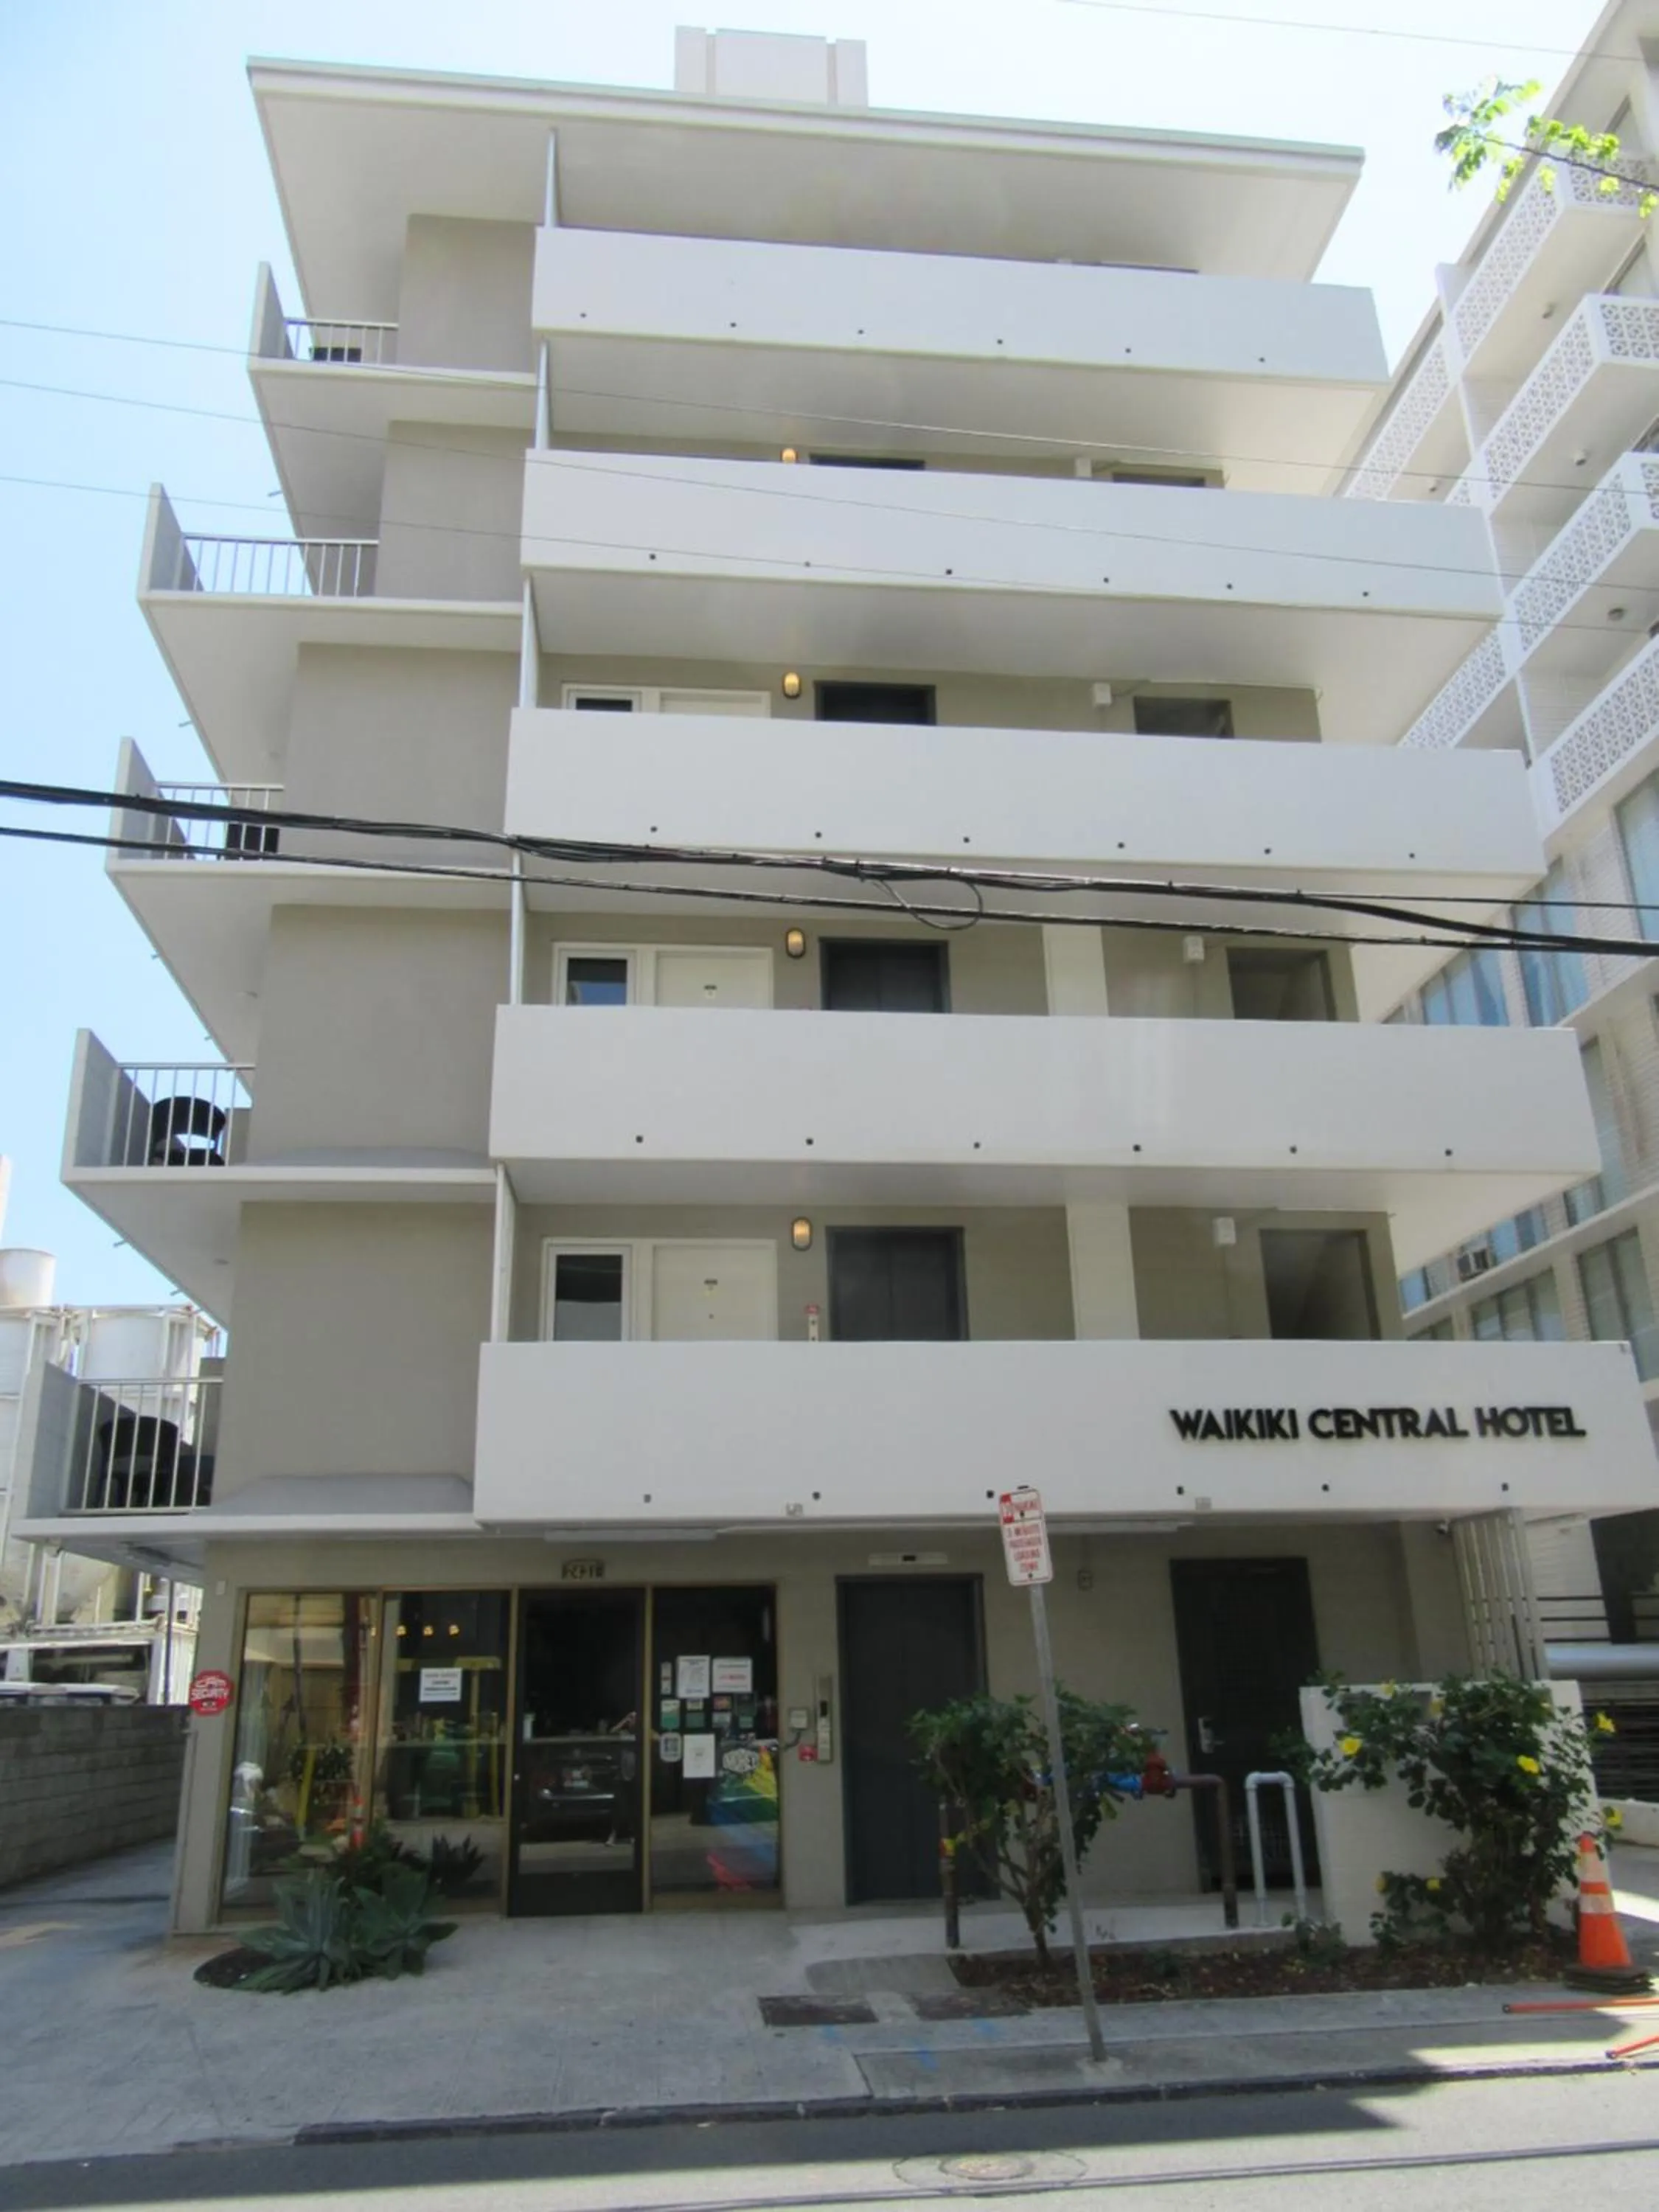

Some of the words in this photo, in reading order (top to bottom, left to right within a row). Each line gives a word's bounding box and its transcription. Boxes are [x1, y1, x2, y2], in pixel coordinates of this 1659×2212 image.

[1169, 1408, 1299, 1441] WAIKIKI
[1308, 1408, 1469, 1439] CENTRAL
[1475, 1406, 1587, 1437] HOTEL
